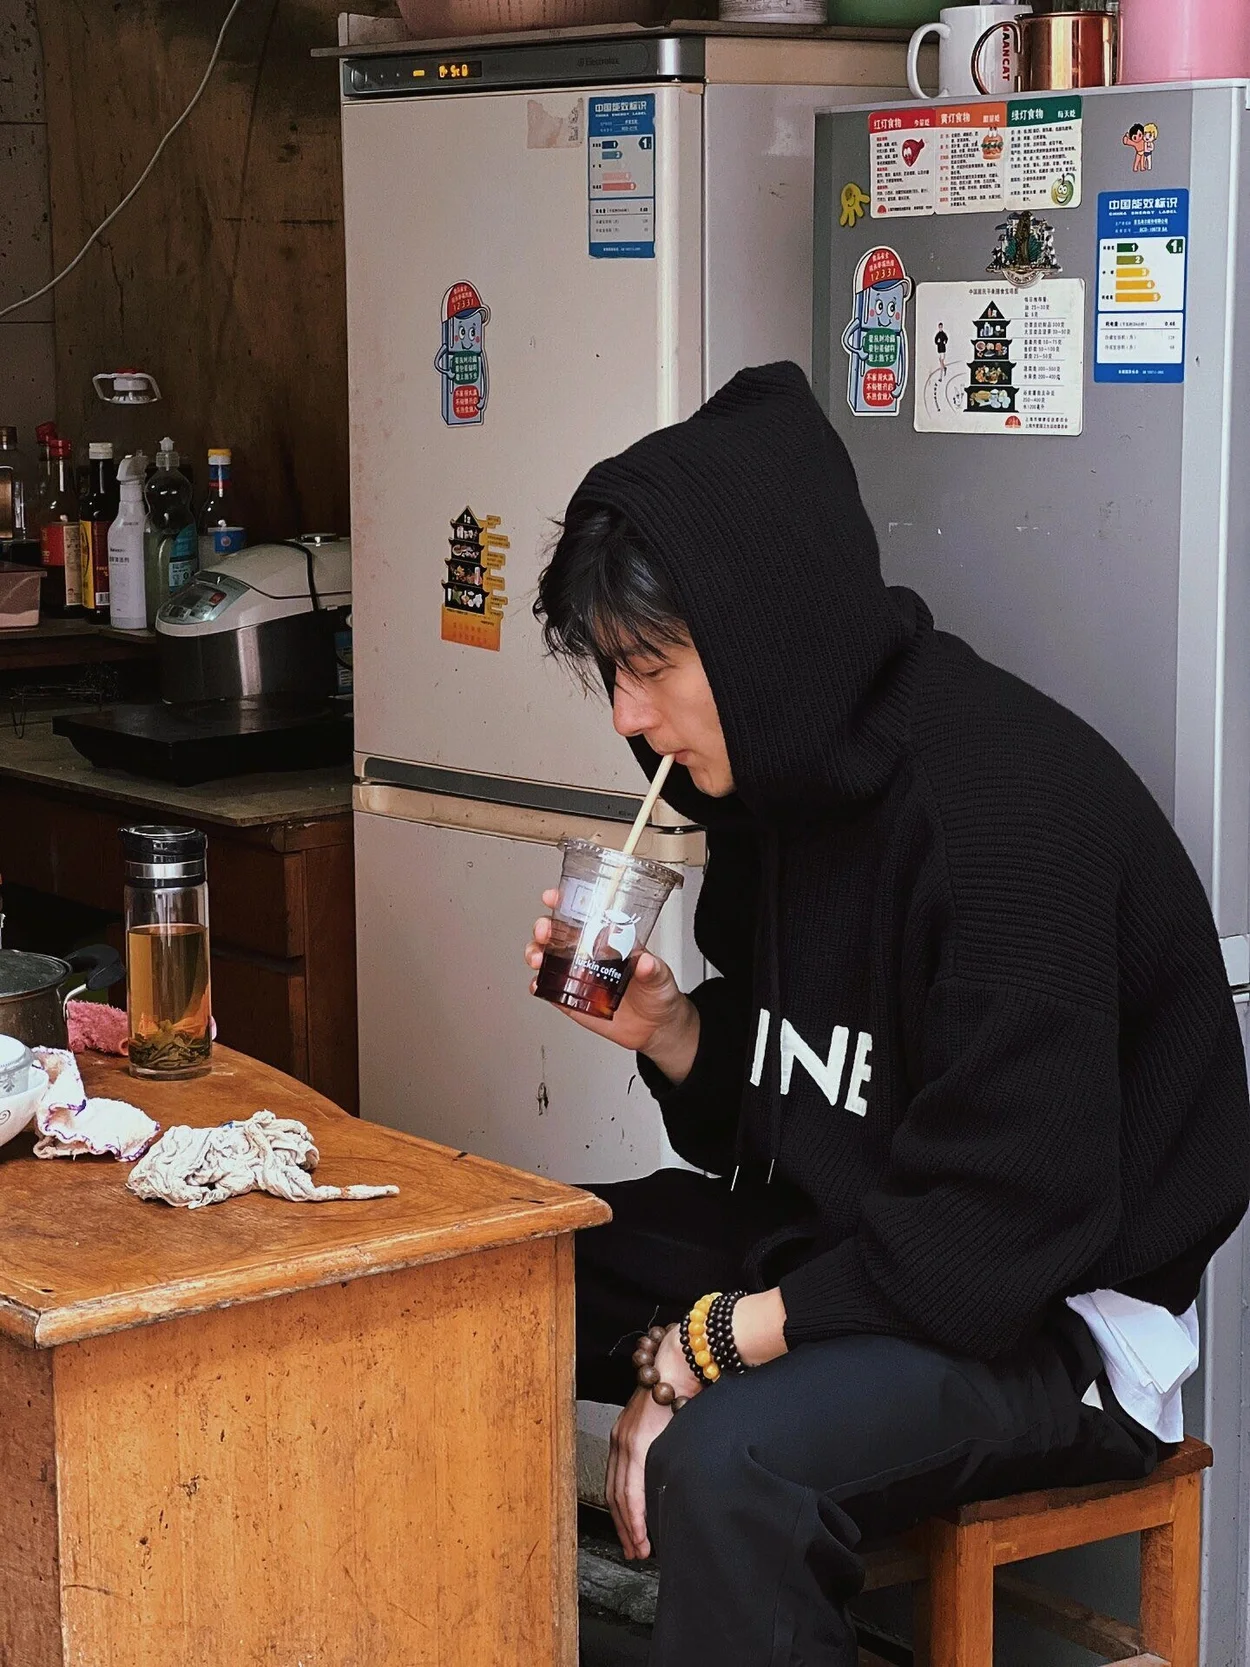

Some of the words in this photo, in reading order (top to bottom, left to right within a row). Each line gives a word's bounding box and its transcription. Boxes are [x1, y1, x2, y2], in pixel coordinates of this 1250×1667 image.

[940, 112, 971, 124] 黄灯食物
[1011, 108, 1044, 121] 绿灯食物
[873, 118, 902, 130] 红灯食物
[1108, 197, 1178, 210] 中国能效标识
[1135, 256, 1141, 264] 2
[870, 268, 896, 281] 12331
[453, 298, 475, 312] 12331
[600, 966, 622, 980] coffee
